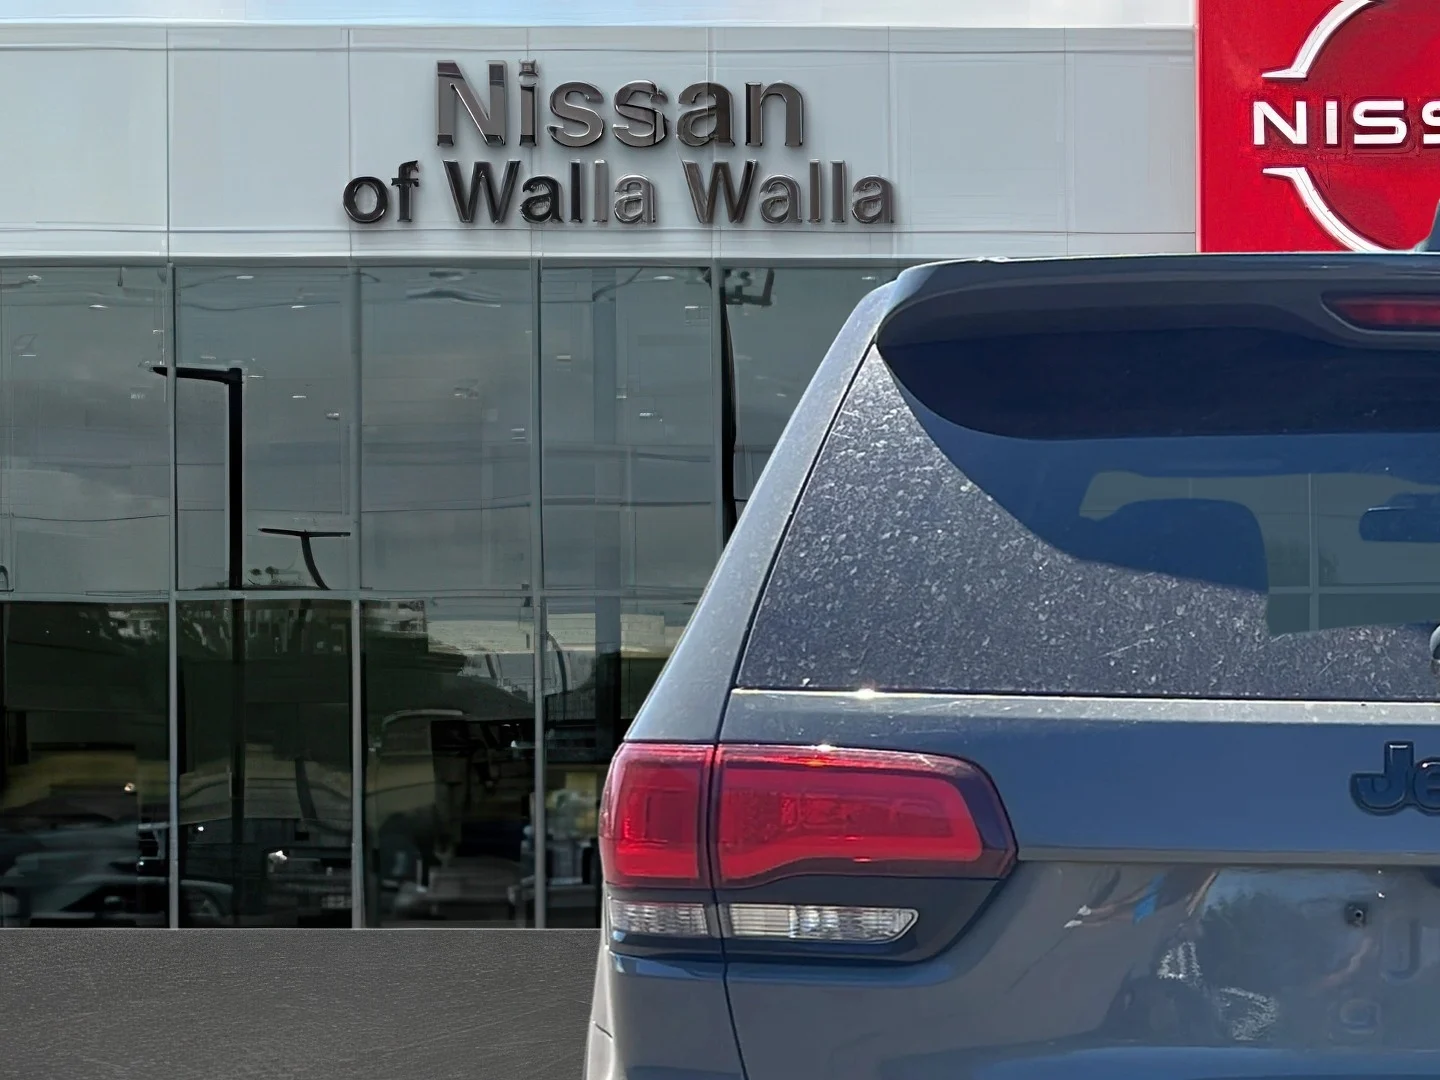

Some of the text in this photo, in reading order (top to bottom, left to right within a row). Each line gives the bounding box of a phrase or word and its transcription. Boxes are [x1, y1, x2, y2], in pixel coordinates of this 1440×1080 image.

[435, 59, 806, 148] Nissan
[343, 160, 896, 225] of Walla Walla
